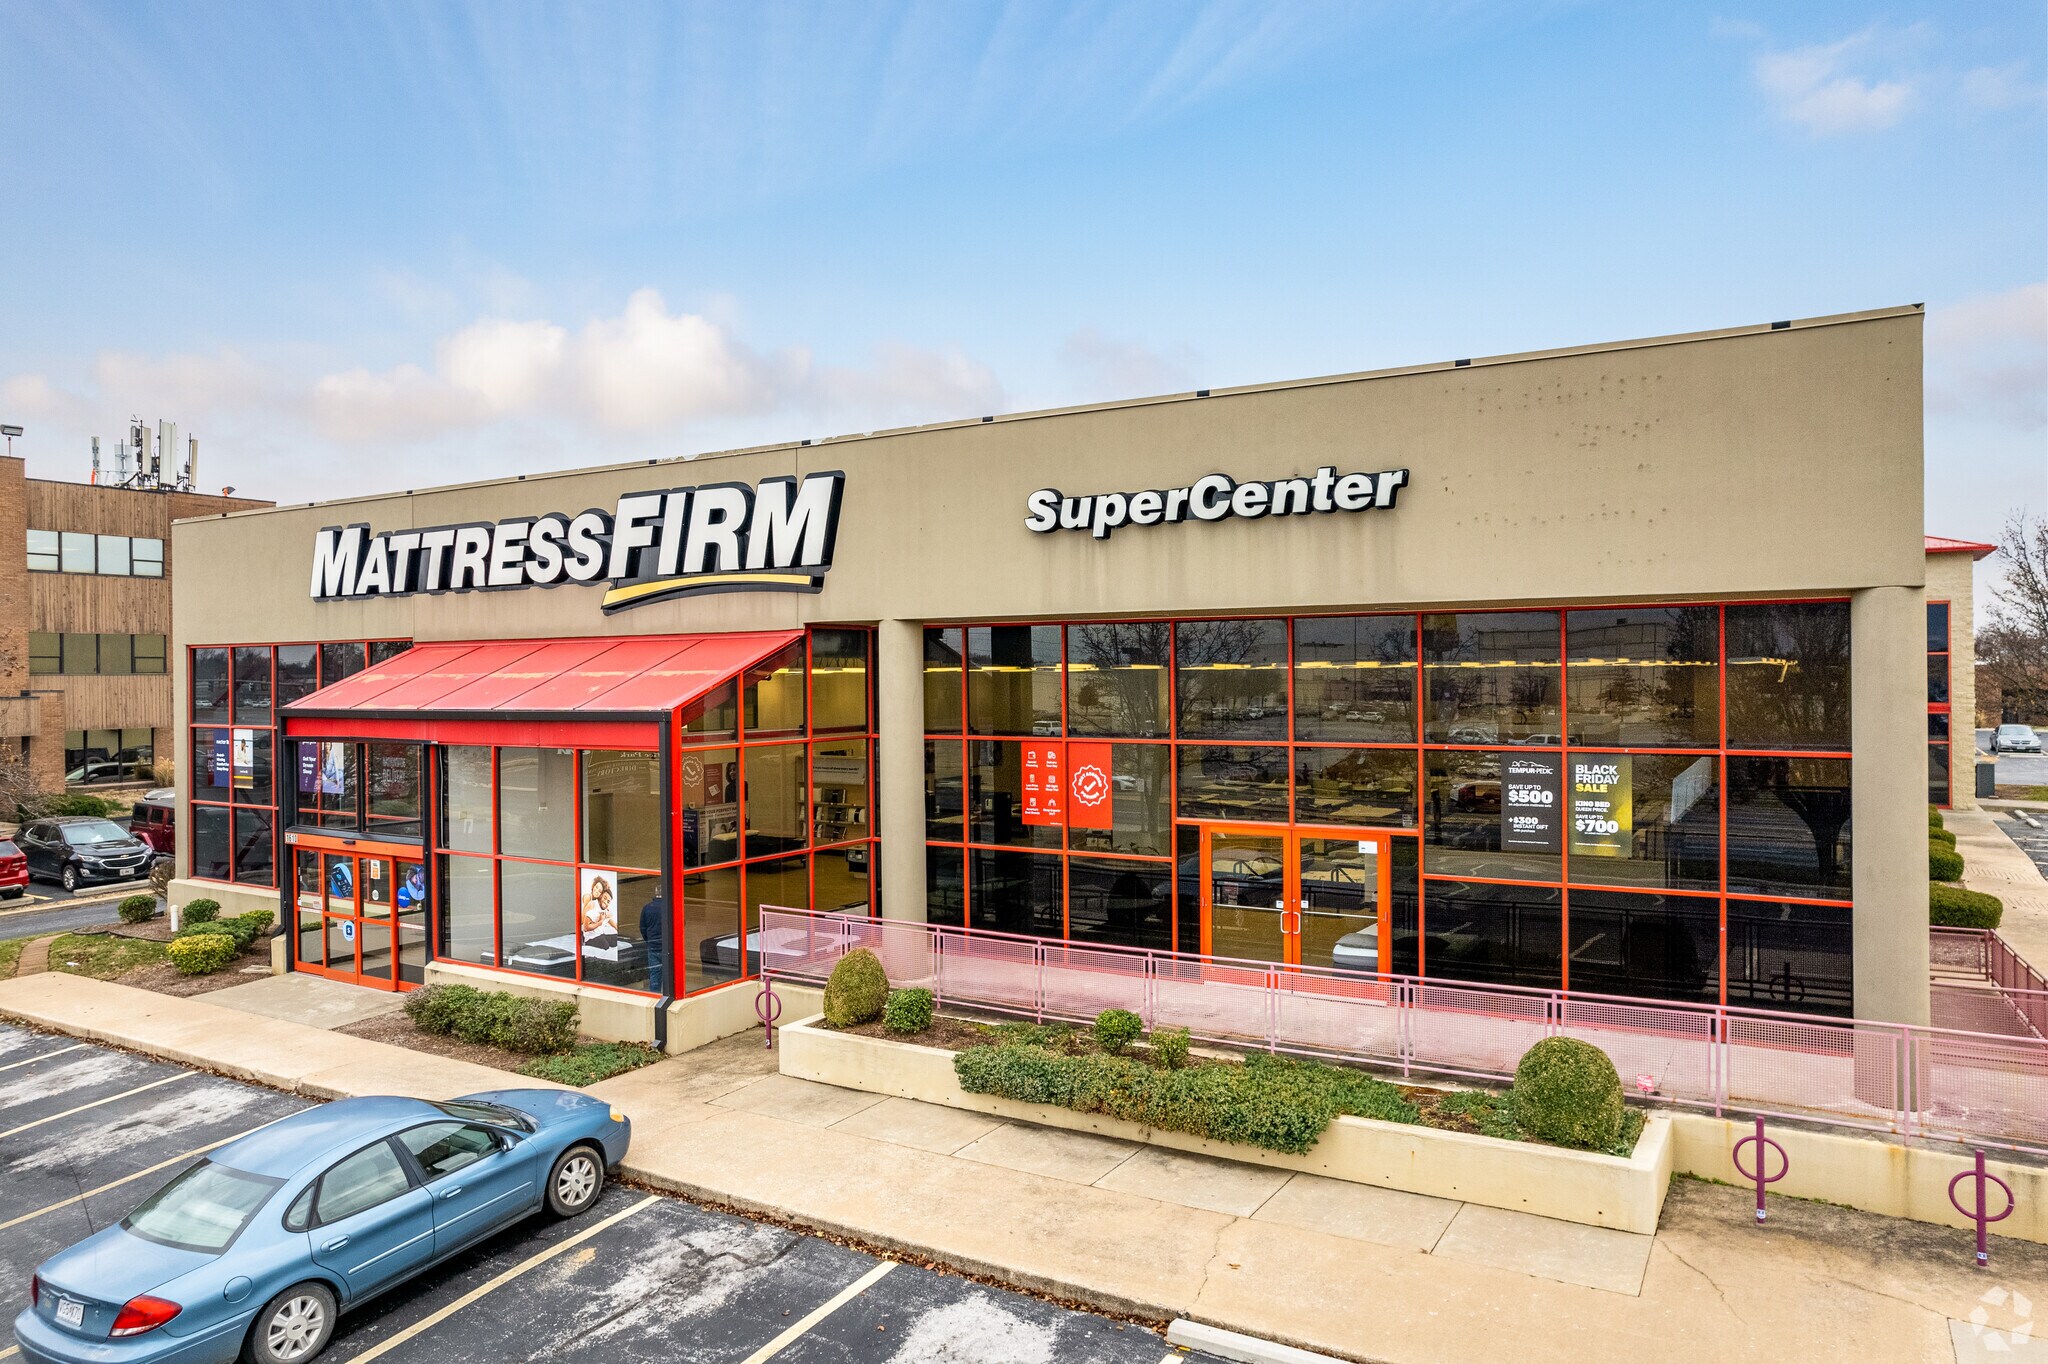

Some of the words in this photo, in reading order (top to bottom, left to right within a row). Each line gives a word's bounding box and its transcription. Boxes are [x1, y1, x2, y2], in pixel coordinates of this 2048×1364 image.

[1024, 466, 1409, 539] SuperCenter
[1575, 764, 1618, 774] BLACK
[1575, 774, 1620, 785] FRIDAY
[1575, 784, 1608, 793] SALE
[1508, 790, 1553, 804] $500
[1508, 816, 1538, 824] +$300
[1575, 820, 1619, 833] $700
